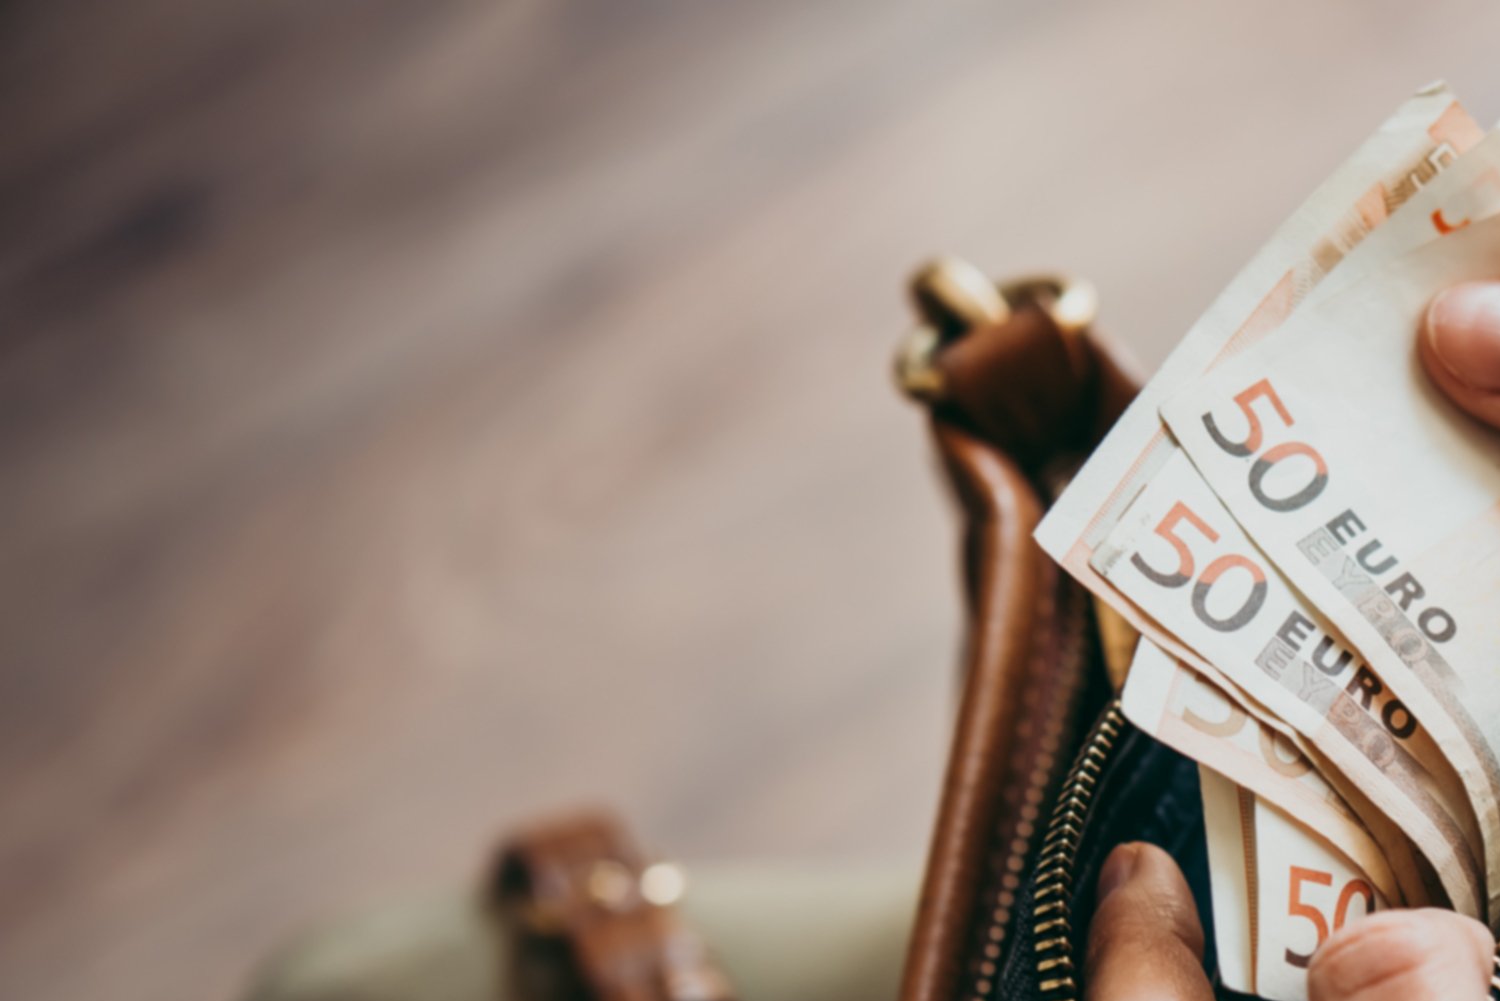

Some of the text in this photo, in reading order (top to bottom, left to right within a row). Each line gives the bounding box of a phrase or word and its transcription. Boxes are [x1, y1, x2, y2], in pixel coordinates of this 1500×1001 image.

[1131, 501, 1267, 632] 50
[1275, 610, 1417, 739] EURO
[1201, 378, 1456, 643] 50 EURO
